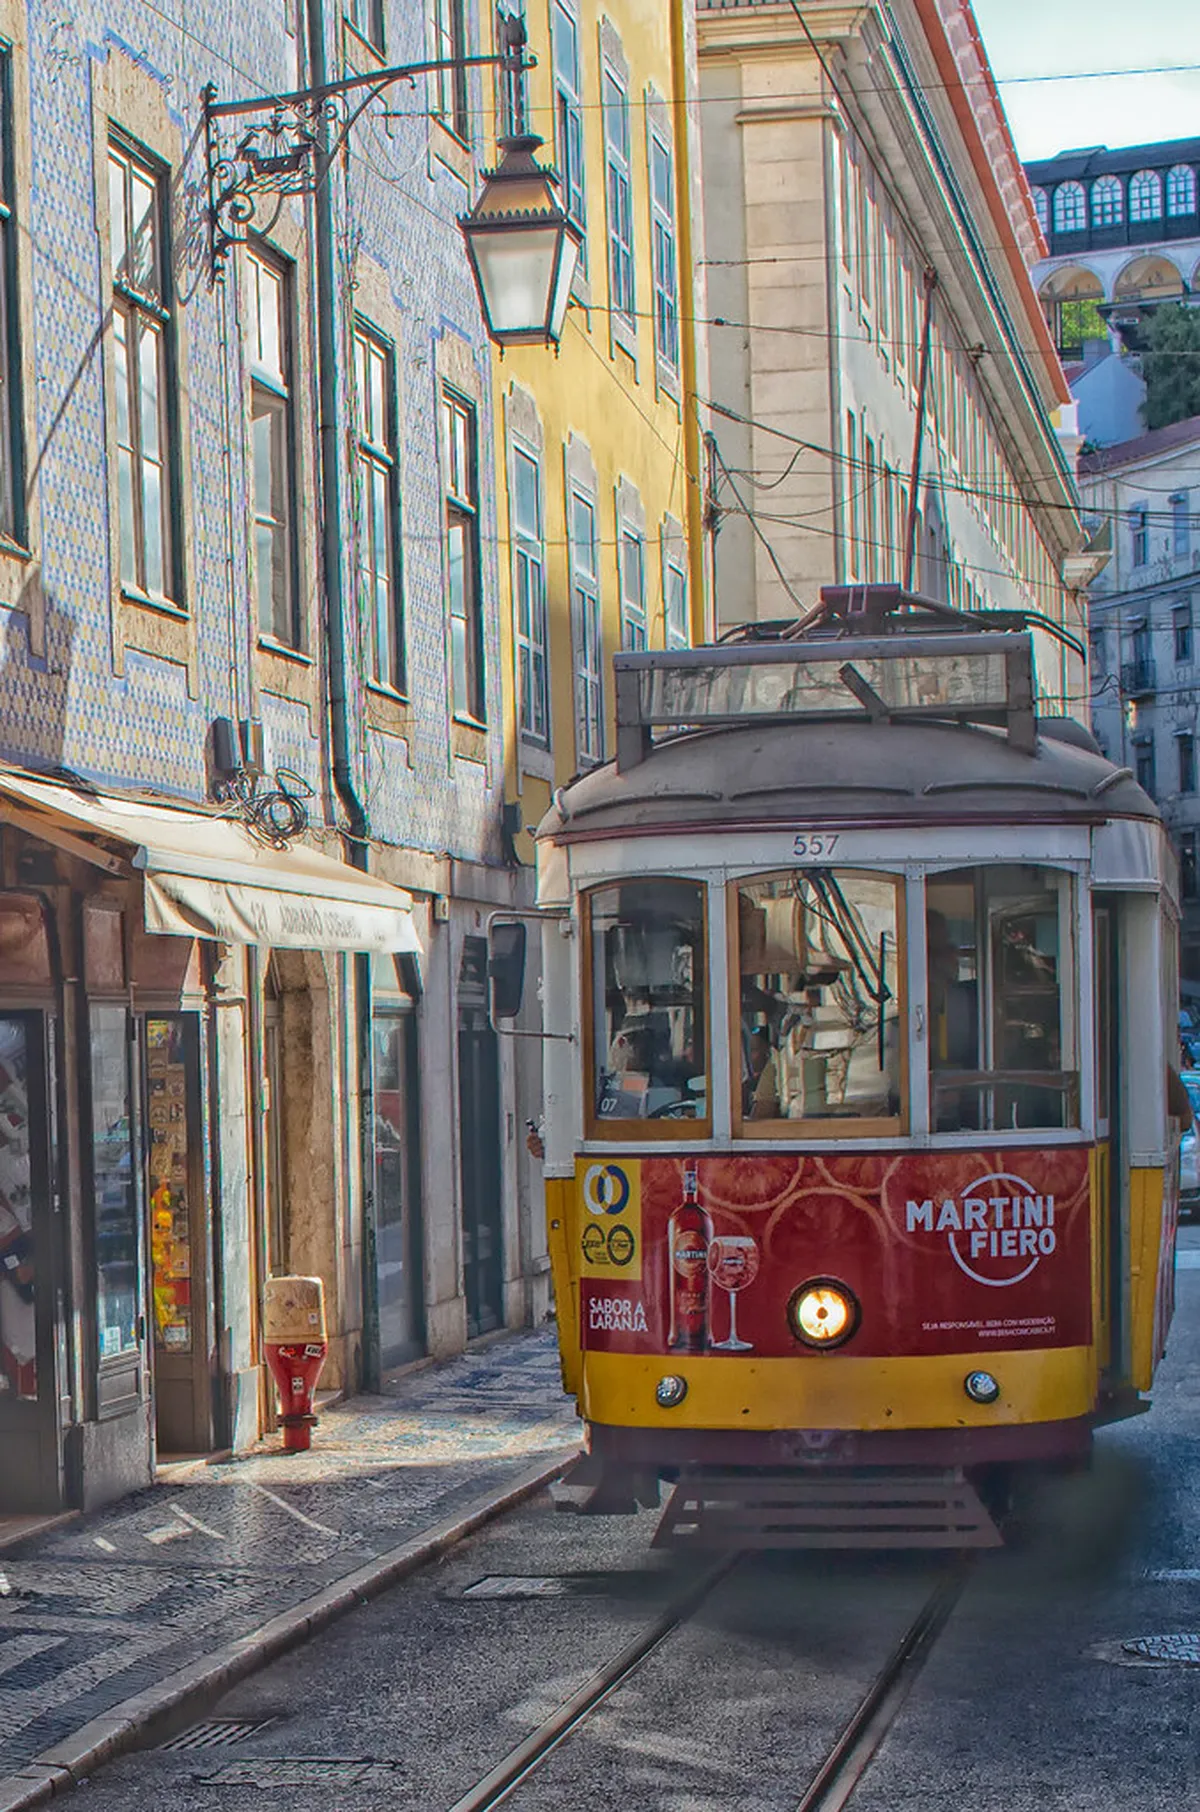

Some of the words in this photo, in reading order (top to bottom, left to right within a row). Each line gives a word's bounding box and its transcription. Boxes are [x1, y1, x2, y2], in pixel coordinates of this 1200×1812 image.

[793, 834, 839, 856] 557
[601, 1098, 617, 1112] 07
[906, 1195, 1054, 1232] MARTINI
[970, 1228, 1056, 1258] FIERO
[589, 1297, 632, 1316] SABOR
[634, 1300, 646, 1316] A
[589, 1313, 648, 1332] LARANJA
